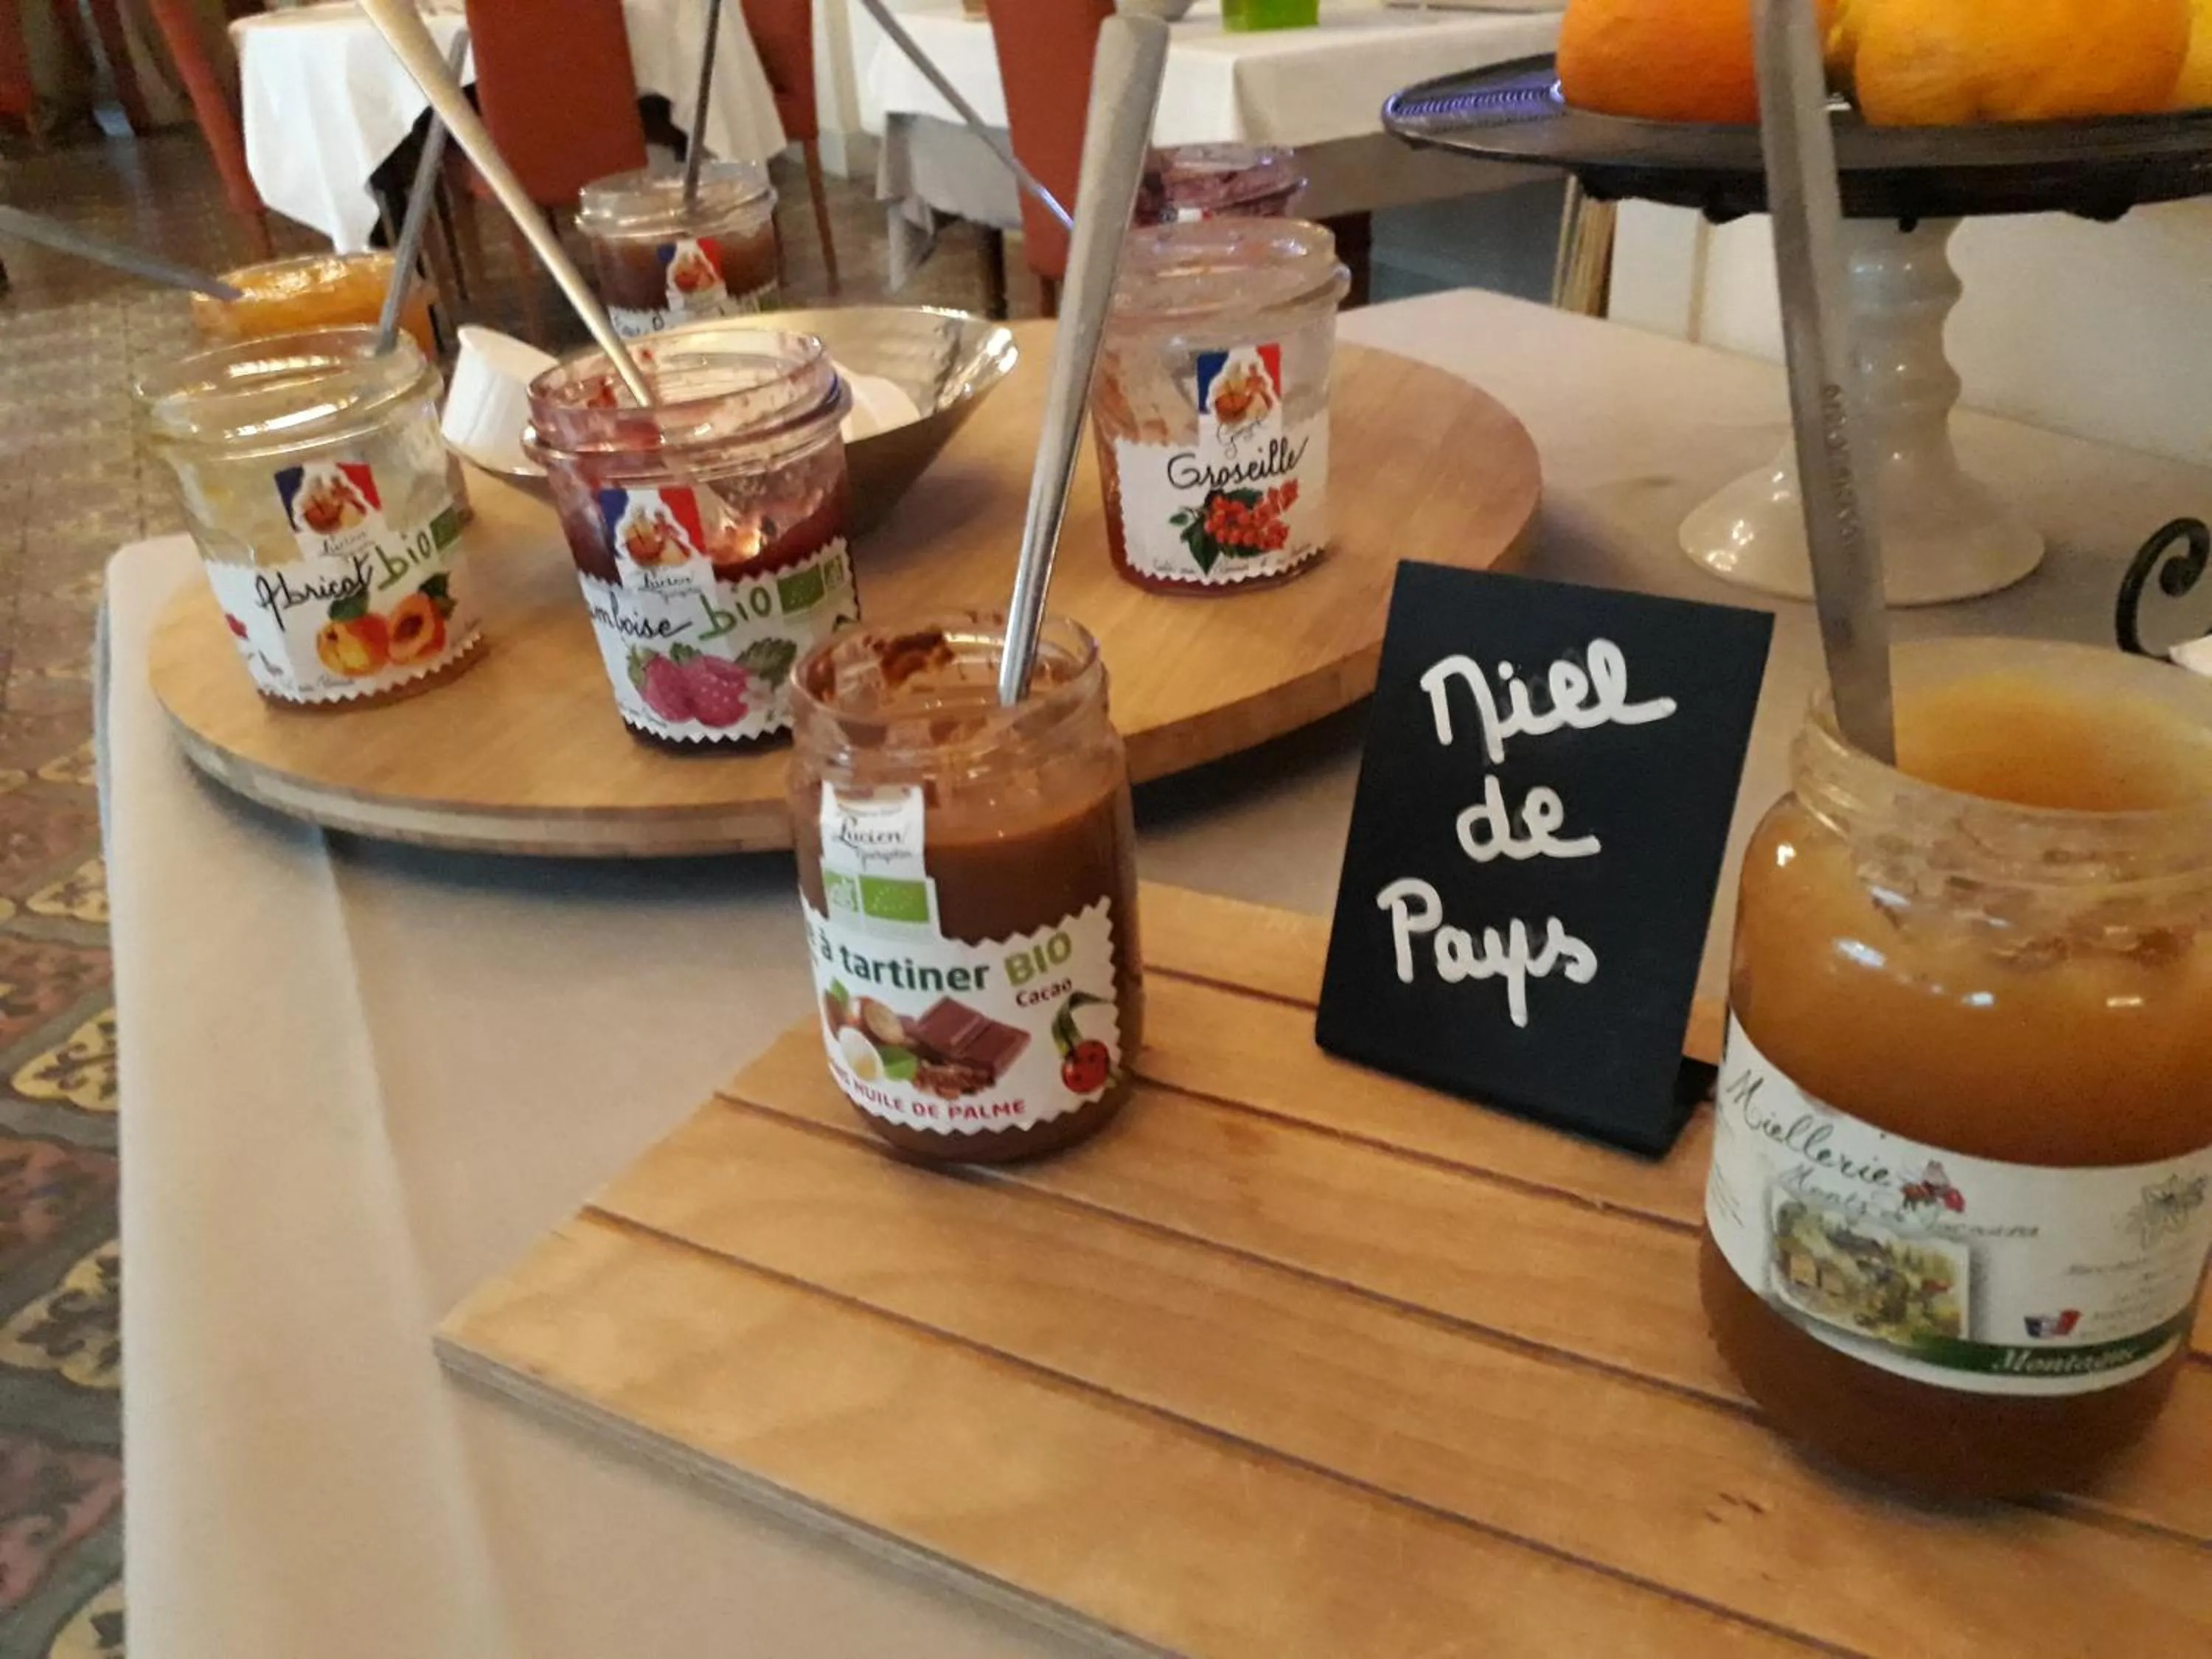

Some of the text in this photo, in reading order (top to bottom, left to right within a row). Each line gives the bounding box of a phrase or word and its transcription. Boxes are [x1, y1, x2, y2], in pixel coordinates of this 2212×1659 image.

[1166, 437, 1309, 490] Groseille
[255, 529, 431, 633] Abricot bio
[698, 585, 772, 641] bio
[1455, 774, 1601, 863] de
[839, 945, 990, 992] tartiner
[1004, 931, 1073, 987] BIO
[1377, 877, 1598, 1028] Pays
[1016, 977, 1074, 1009] Cacao
[853, 1077, 1026, 1121] HUILE DE PALME
[1726, 1068, 1892, 1188] Miellerie
